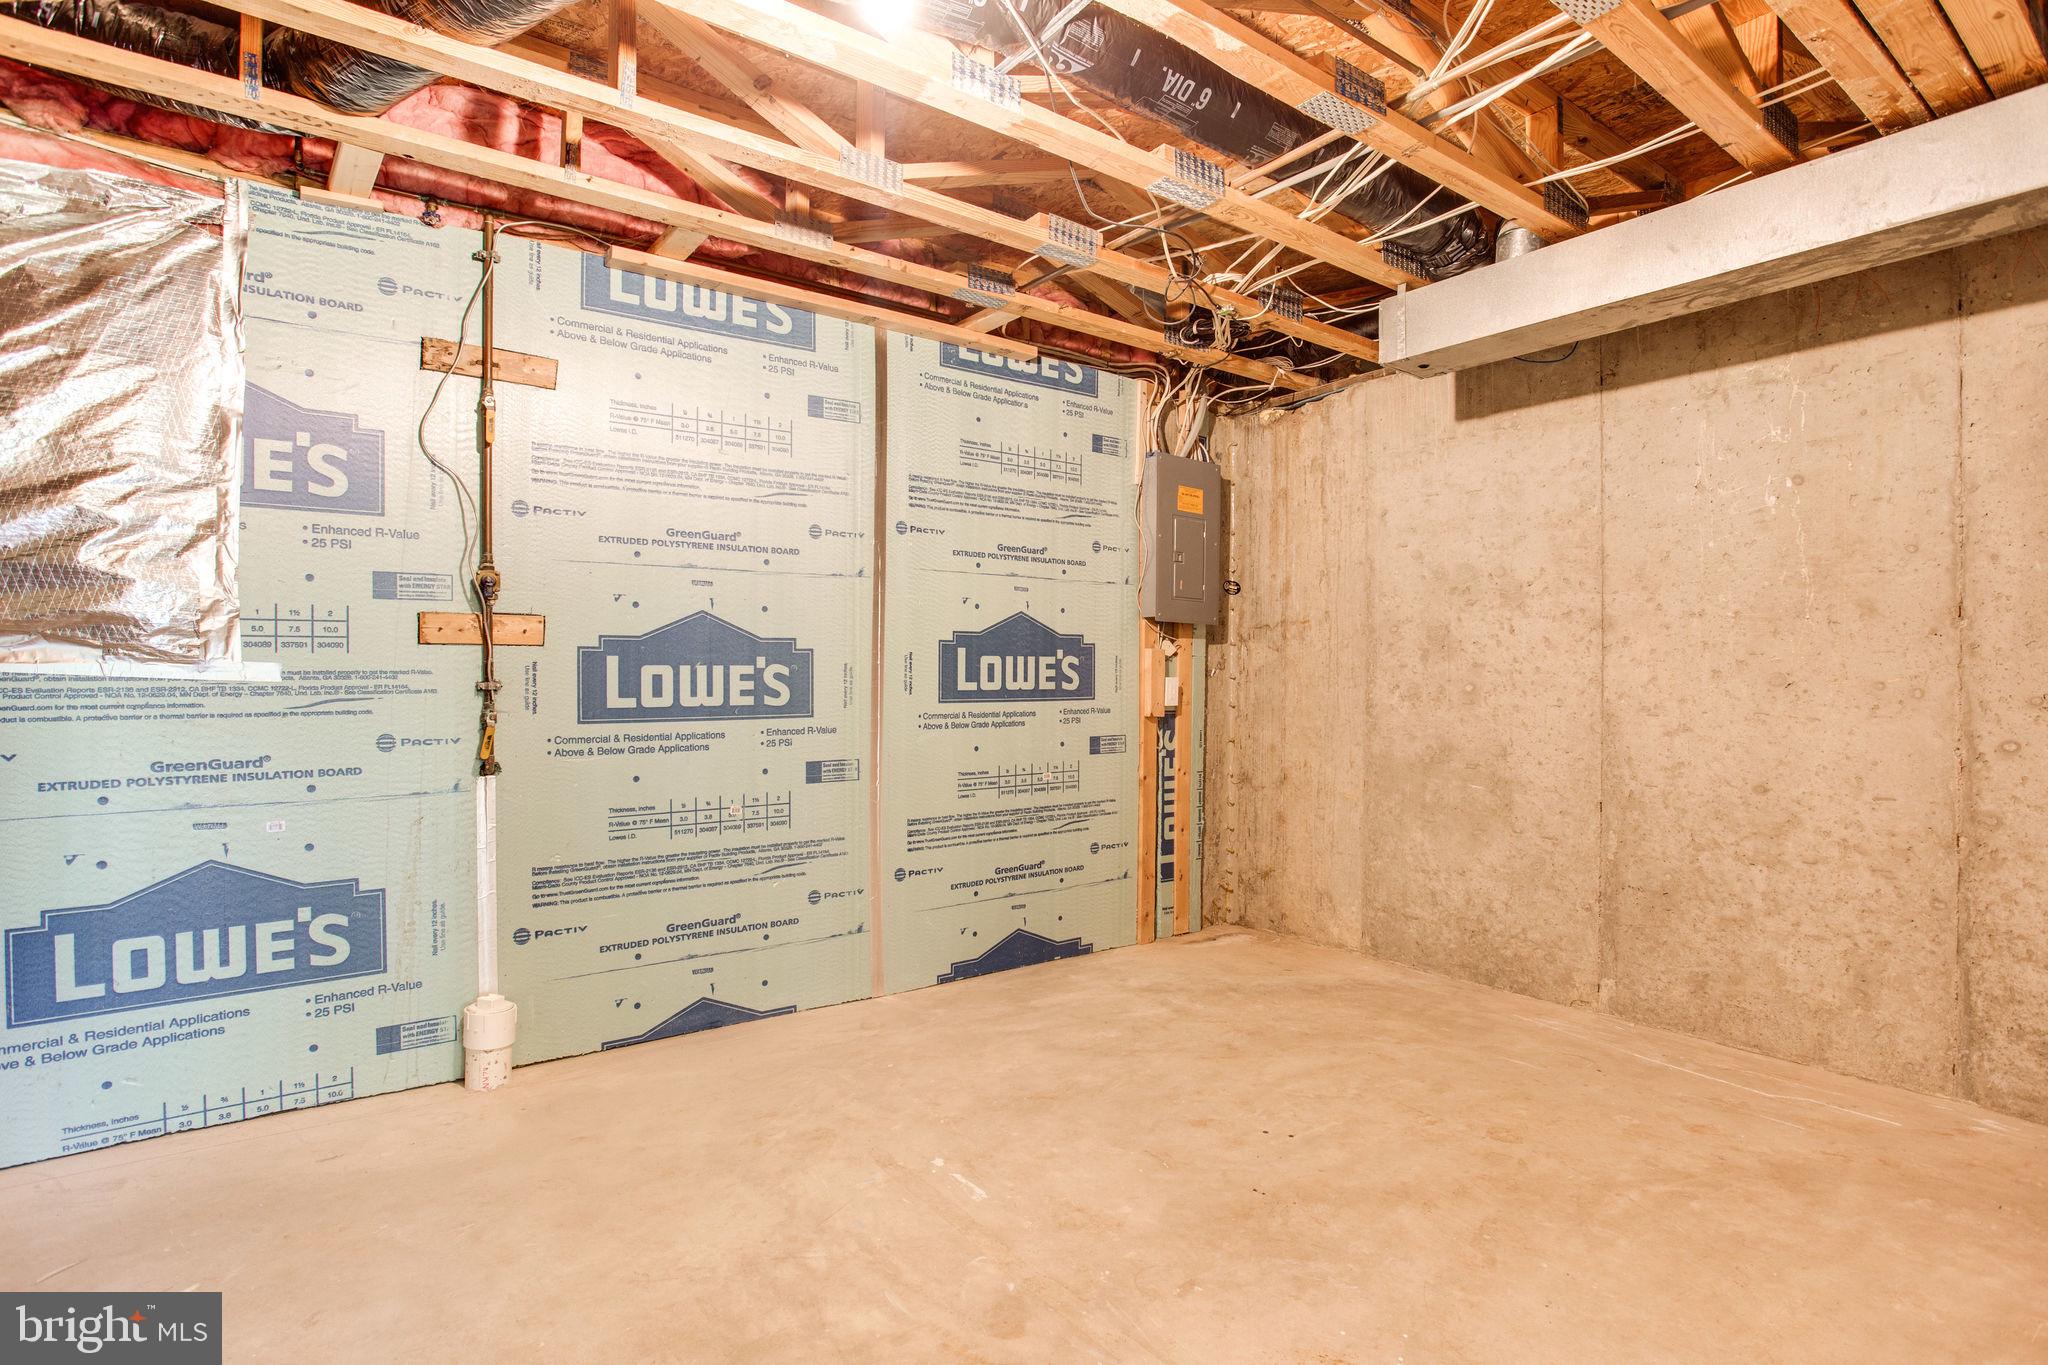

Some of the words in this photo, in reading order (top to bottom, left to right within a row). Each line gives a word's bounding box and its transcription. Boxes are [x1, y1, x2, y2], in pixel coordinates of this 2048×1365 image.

[1162, 66, 1196, 102] DIA.
[243, 284, 316, 306] NSULATION
[319, 297, 364, 313] BOARD
[608, 266, 795, 336] LOWES
[557, 316, 615, 338] Commercial
[616, 327, 624, 337] &
[625, 327, 675, 346] Residential
[677, 337, 729, 355] Applications
[556, 329, 588, 342] Above
[589, 334, 597, 344] &
[599, 336, 628, 350] Below
[630, 341, 658, 354] Grade
[660, 345, 713, 364] Applications
[768, 353, 807, 369] Enhanced
[809, 360, 839, 373] R-Value
[768, 364, 779, 374] 25
[780, 366, 795, 376] PSI
[924, 372, 962, 388] Commercial
[963, 379, 969, 387] &
[969, 381, 1003, 394] Residential
[1004, 388, 1040, 402] Applications
[924, 382, 944, 392] Above
[952, 388, 971, 399] Below
[972, 392, 992, 403] Grade
[993, 396, 1029, 409] Applications
[1066, 399, 1092, 412] Enhanced
[1066, 409, 1074, 417] 25
[1074, 410, 1084, 419] PSI
[532, 505, 587, 517] PACTIV
[311, 523, 372, 538] Enhanced
[375, 528, 421, 541] R-Value
[824, 528, 865, 540] PACTIV
[910, 524, 945, 536] PACTIV
[311, 537, 327, 549] 25
[330, 538, 353, 550] PSI
[598, 535, 649, 547] EXTRUDED
[651, 539, 714, 550] POLYSTYRENE
[716, 543, 769, 555] INSULATION
[770, 546, 800, 556] BOARD
[1102, 543, 1130, 554] PACTV
[952, 549, 986, 560] EXTRUDED
[987, 551, 1029, 563] POLYSTYRENE
[1030, 554, 1066, 566] INSULATION
[1066, 557, 1087, 568] BOARD
[327, 609, 333, 617] 2
[251, 625, 264, 633] 5.0
[957, 647, 1080, 691] LOWE'S
[606, 655, 791, 709] LOWE'S
[27, 714, 74, 723] combustible.
[83, 713, 118, 723] protective
[119, 713, 143, 722] barrier
[159, 712, 185, 721] thermal
[186, 711, 208, 720] barrier
[216, 711, 243, 721] required
[253, 710, 282, 720] specified
[289, 710, 300, 718] the
[300, 709, 334, 719] appropriate
[335, 708, 358, 718] building
[922, 711, 961, 720] Commercial
[961, 711, 967, 719] &
[968, 709, 1001, 719] Residential
[1002, 709, 1037, 719] Applications
[1063, 707, 1090, 716] Enhanced
[1090, 706, 1111, 715] R-Value
[922, 721, 943, 730] Above
[944, 722, 950, 730] &
[950, 720, 970, 730] Below
[971, 720, 990, 729] Grade
[990, 719, 1026, 729] Applications
[1063, 717, 1071, 725] 25
[1071, 716, 1082, 725] PSI
[554, 735, 611, 745] Commercial
[613, 734, 620, 743] &
[623, 732, 673, 742] Residential
[674, 730, 726, 742] Applications
[766, 727, 806, 737] Enhanced
[807, 726, 837, 735] R-Value
[401, 737, 462, 747] PACTIV
[554, 748, 585, 757] Above
[587, 747, 594, 756] &
[597, 746, 625, 756] Below
[628, 745, 655, 754] Grade
[657, 742, 710, 754] Applications
[766, 739, 776, 748] 25
[37, 778, 122, 793] EXTRUDED
[126, 773, 228, 788] POLYSTYRENE
[232, 769, 314, 782] INSULATION
[317, 766, 363, 778] BOARD
[1101, 840, 1129, 851] PACTIV
[908, 866, 944, 878] PACTIV
[950, 878, 984, 891] EXTRUDED
[985, 872, 1027, 886] POLYSTYRENE
[1028, 867, 1063, 880] INSULATION
[1064, 863, 1085, 875] BOARD
[823, 888, 865, 900] PACTIV
[534, 924, 589, 940] PACTIV
[599, 938, 649, 954] EXTRUDED
[651, 931, 714, 946] POLYSTYRENE
[716, 922, 768, 937] INSULATION
[769, 917, 800, 930] BOARD
[54, 907, 351, 1003] LOWE'S
[314, 985, 375, 1005] Enhanced
[377, 979, 423, 995] R-Value
[314, 1006, 331, 1019] 25
[333, 1002, 356, 1016] PSI
[0, 1035, 64, 1056] mmercial
[68, 1033, 79, 1045] &
[84, 1020, 166, 1043] Residential
[169, 1007, 251, 1030] Applications
[24, 1055, 36, 1067] &
[41, 1048, 88, 1065] Below
[92, 1039, 138, 1056] Grade
[142, 1026, 226, 1049] Applications
[178, 1119, 193, 1129] 3.0
[256, 1103, 270, 1113] 5.0
